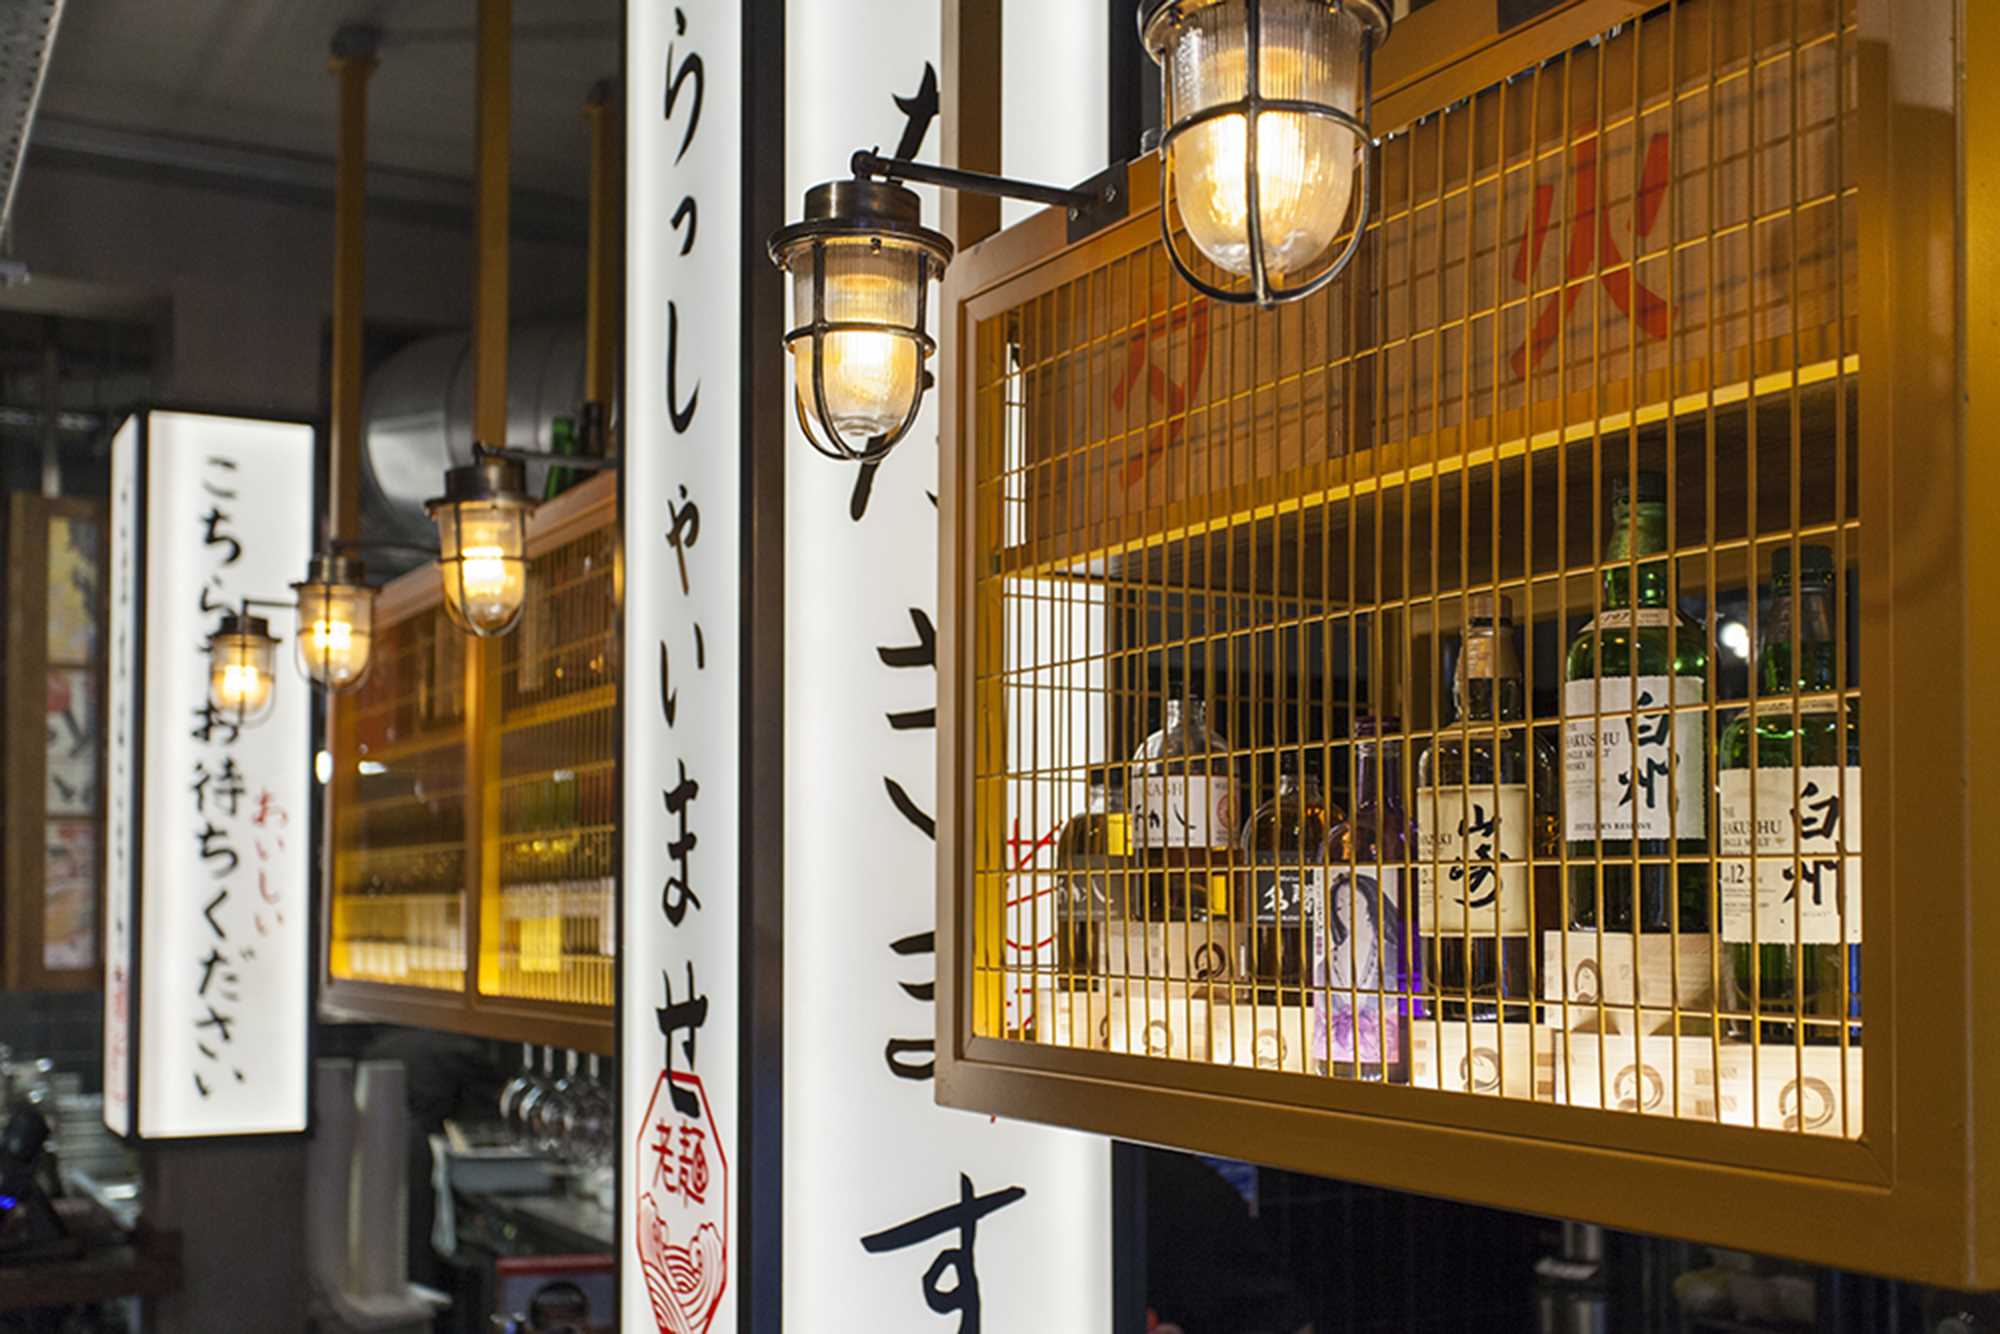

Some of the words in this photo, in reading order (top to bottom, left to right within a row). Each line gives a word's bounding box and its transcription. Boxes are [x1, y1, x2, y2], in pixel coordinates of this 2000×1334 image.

[1511, 119, 1678, 380] 火
[1618, 690, 1680, 820] 白州
[251, 788, 288, 937] おいしい
[1782, 781, 1842, 917] 白州
